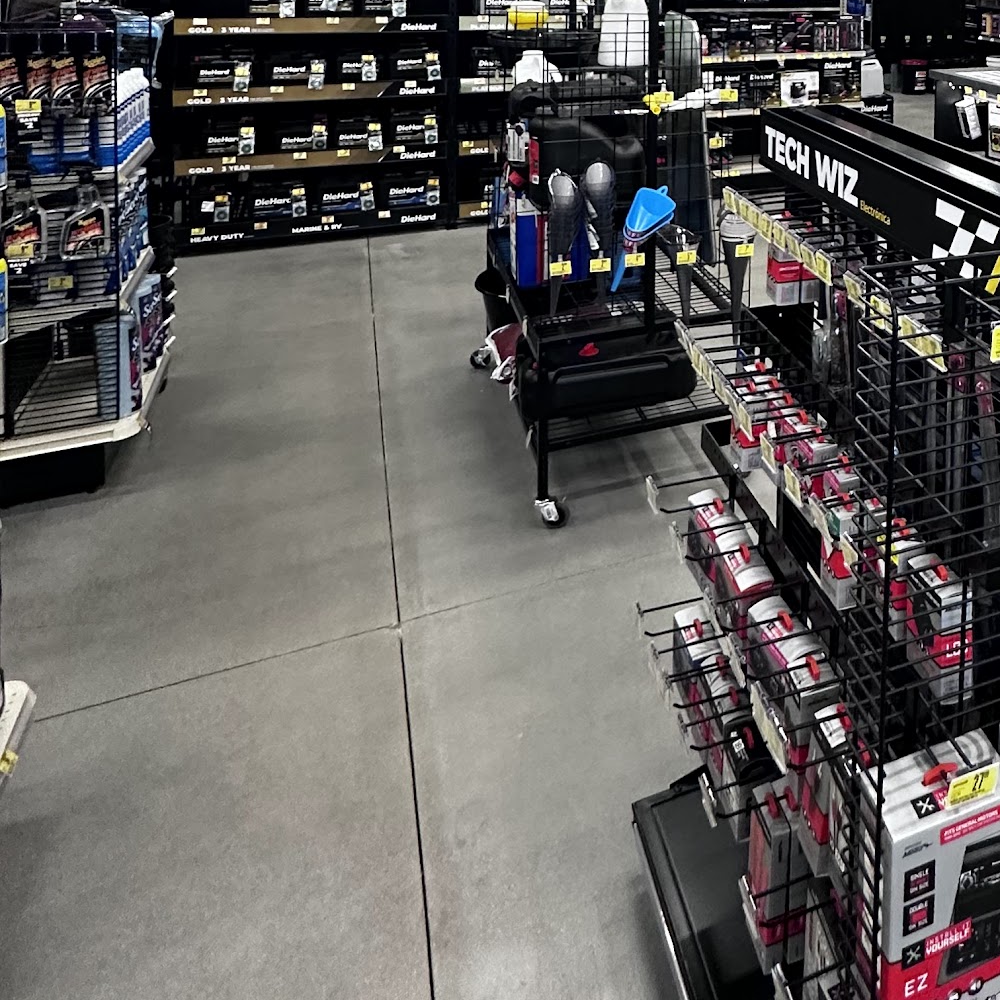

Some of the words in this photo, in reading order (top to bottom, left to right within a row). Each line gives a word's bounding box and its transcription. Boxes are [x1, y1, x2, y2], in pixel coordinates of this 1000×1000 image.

[188, 26, 213, 34] GOLD
[401, 23, 437, 32] DieHard
[397, 58, 422, 67] DieHard
[824, 61, 852, 70] DieHard
[200, 68, 230, 77] DieHard
[273, 66, 306, 75] DieHard
[399, 86, 435, 95] DieHard
[187, 97, 212, 105] GOLD
[861, 104, 888, 113] DieHard
[281, 135, 312, 144] DieHard
[339, 133, 368, 141] DieHard
[400, 150, 436, 159] DieHard
[188, 167, 214, 175] GOLD
[228, 164, 250, 172] YEAR
[764, 125, 810, 180] TECH
[814, 150, 859, 208] WIZ
[389, 185, 424, 195] DieHard
[323, 191, 359, 202] DieHard
[860, 200, 891, 225] Electrónica
[401, 213, 436, 224] DieHard
[292, 225, 322, 234] MARINE
[323, 224, 330, 232] &
[331, 222, 342, 230] RV
[190, 233, 219, 244] HEAVY
[220, 232, 244, 242] DUTY
[944, 828, 956, 837] FITS
[956, 819, 978, 832] GENERAL
[978, 810, 999, 823] MOTORS
[926, 927, 960, 947] INSTALL
[962, 921, 971, 930] IT
[926, 927, 969, 955] YOURSELF
[905, 973, 928, 998] EZ
